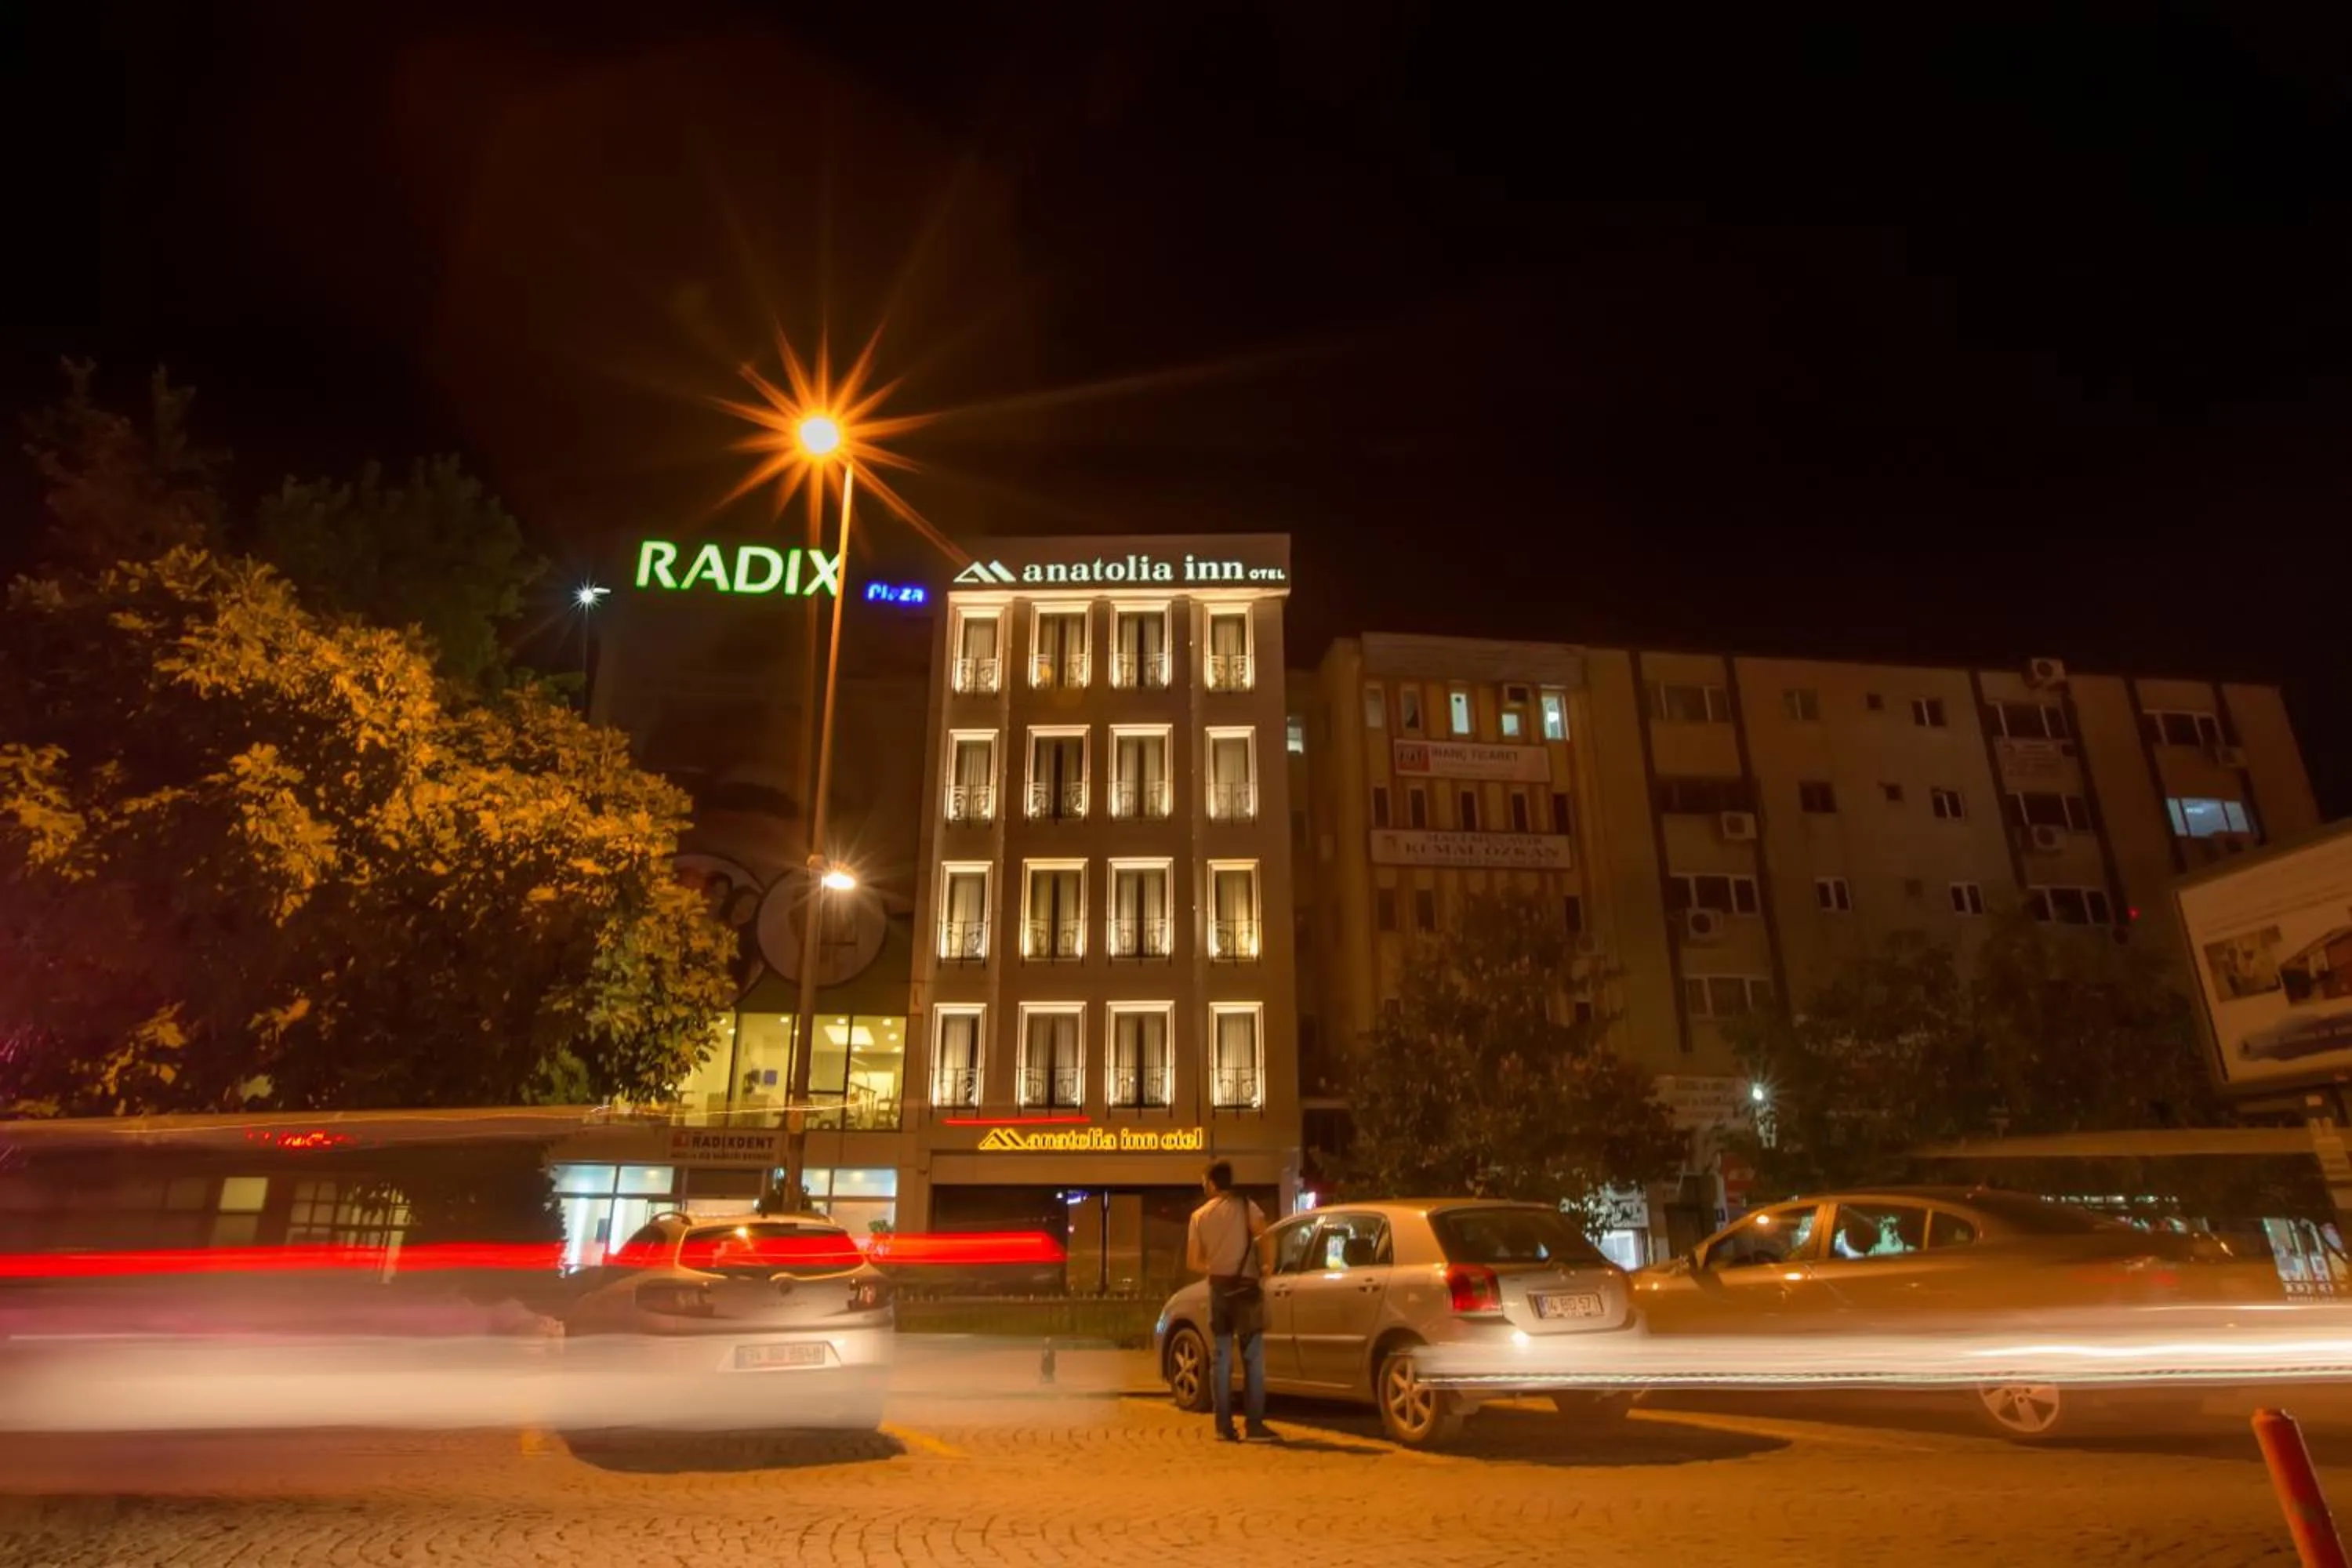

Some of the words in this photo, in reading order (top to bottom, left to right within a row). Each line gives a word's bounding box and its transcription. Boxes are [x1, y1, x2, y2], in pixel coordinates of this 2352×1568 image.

[635, 539, 840, 597] RADIX
[1022, 554, 1174, 582] anatolia
[1185, 554, 1245, 581] inn
[1248, 568, 1286, 580] OTEL
[867, 583, 925, 603] Plaza
[1027, 1127, 1116, 1150] anatolia
[1120, 1127, 1159, 1150] inn
[1160, 1127, 1203, 1150] otel
